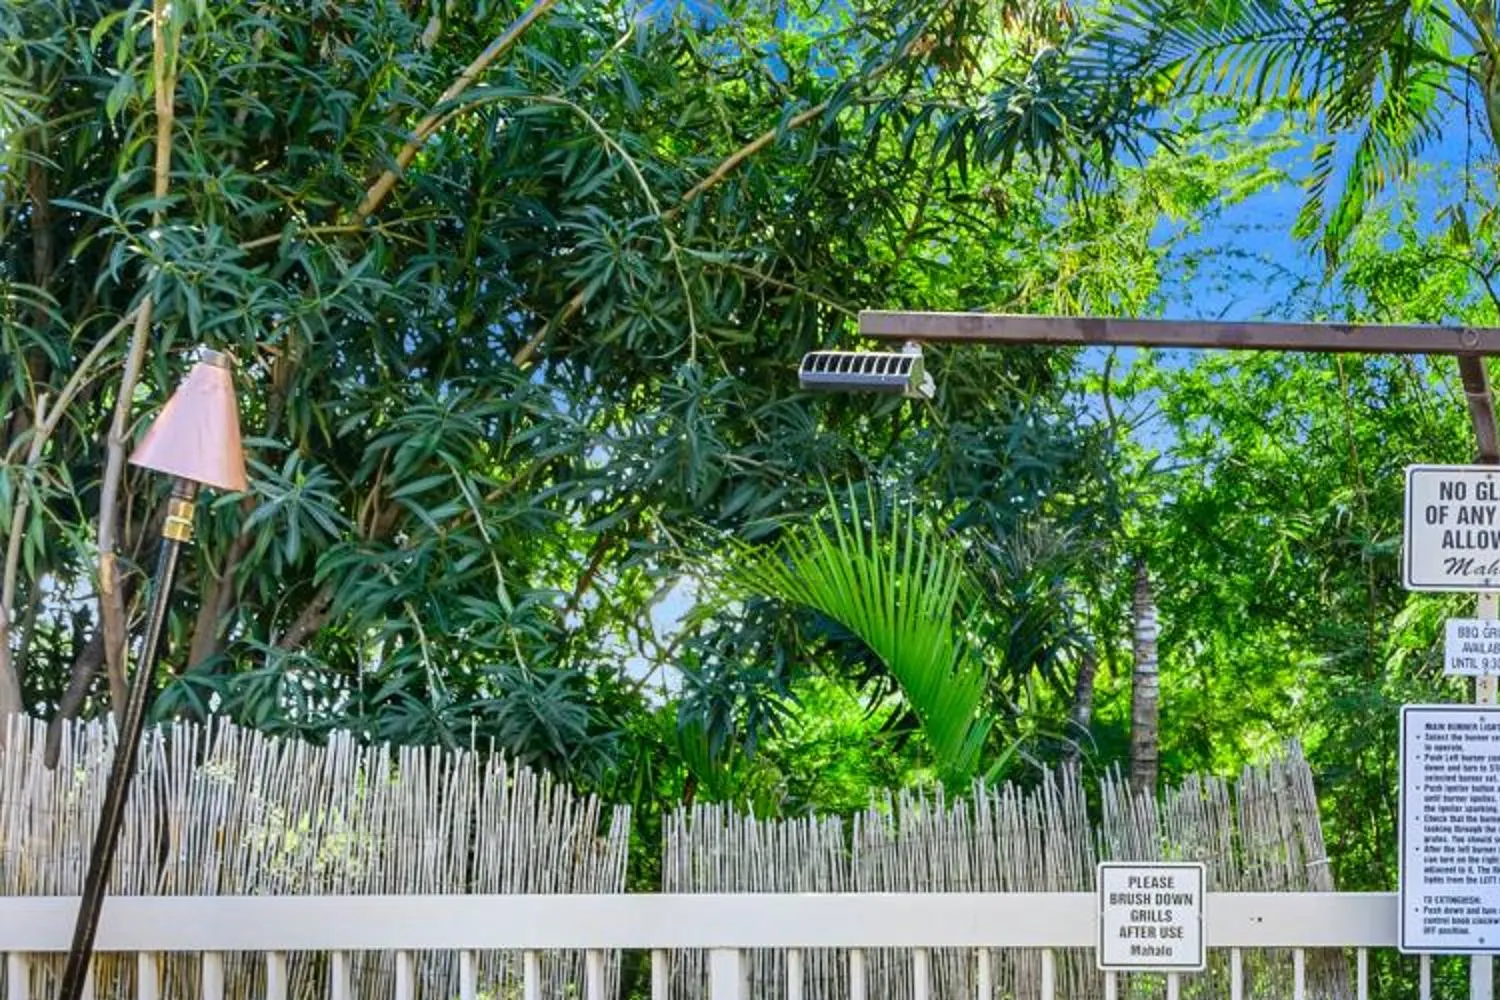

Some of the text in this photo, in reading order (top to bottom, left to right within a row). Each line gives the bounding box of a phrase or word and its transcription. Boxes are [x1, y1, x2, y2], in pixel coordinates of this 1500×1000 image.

[1439, 481, 1467, 500] NO
[1425, 505, 1449, 525] OF
[1456, 506, 1497, 526] ANY
[1457, 625, 1479, 638] BBQ
[1451, 657, 1479, 669] UNTIL
[1425, 723, 1445, 731] MAIN
[1447, 723, 1478, 731] BURNER
[1425, 733, 1449, 742] Select
[1451, 733, 1462, 742] the
[1464, 733, 1489, 742] burner
[1424, 754, 1442, 762] Push
[1461, 754, 1485, 762] burner
[1424, 764, 1444, 772] down
[1447, 764, 1460, 772] and
[1463, 764, 1478, 772] turn
[1480, 764, 1487, 772] to
[1458, 774, 1482, 783] burner
[1424, 784, 1442, 793] Push
[1443, 795, 1468, 804] burner
[1424, 805, 1435, 813] the
[1424, 815, 1447, 823] Check
[1450, 815, 1464, 823] that
[1466, 815, 1477, 823] the
[1484, 825, 1496, 834] the
[1443, 846, 1455, 854] the
[1471, 846, 1496, 854] burner
[1468, 856, 1479, 864] the
[1458, 866, 1465, 875] to
[1477, 866, 1490, 875] The
[1128, 876, 1175, 889] PLEASE
[1446, 876, 1464, 885] from
[1466, 876, 1477, 885] the
[1109, 893, 1193, 906] BRUSH DOWN
[1424, 906, 1441, 915] Push
[1444, 906, 1464, 915] down
[1466, 906, 1480, 915] and
[1482, 906, 1496, 915] turn
[1130, 909, 1173, 922] GRILLS
[1119, 926, 1184, 939] AFTER USE
[1130, 944, 1173, 957] Mahalo
